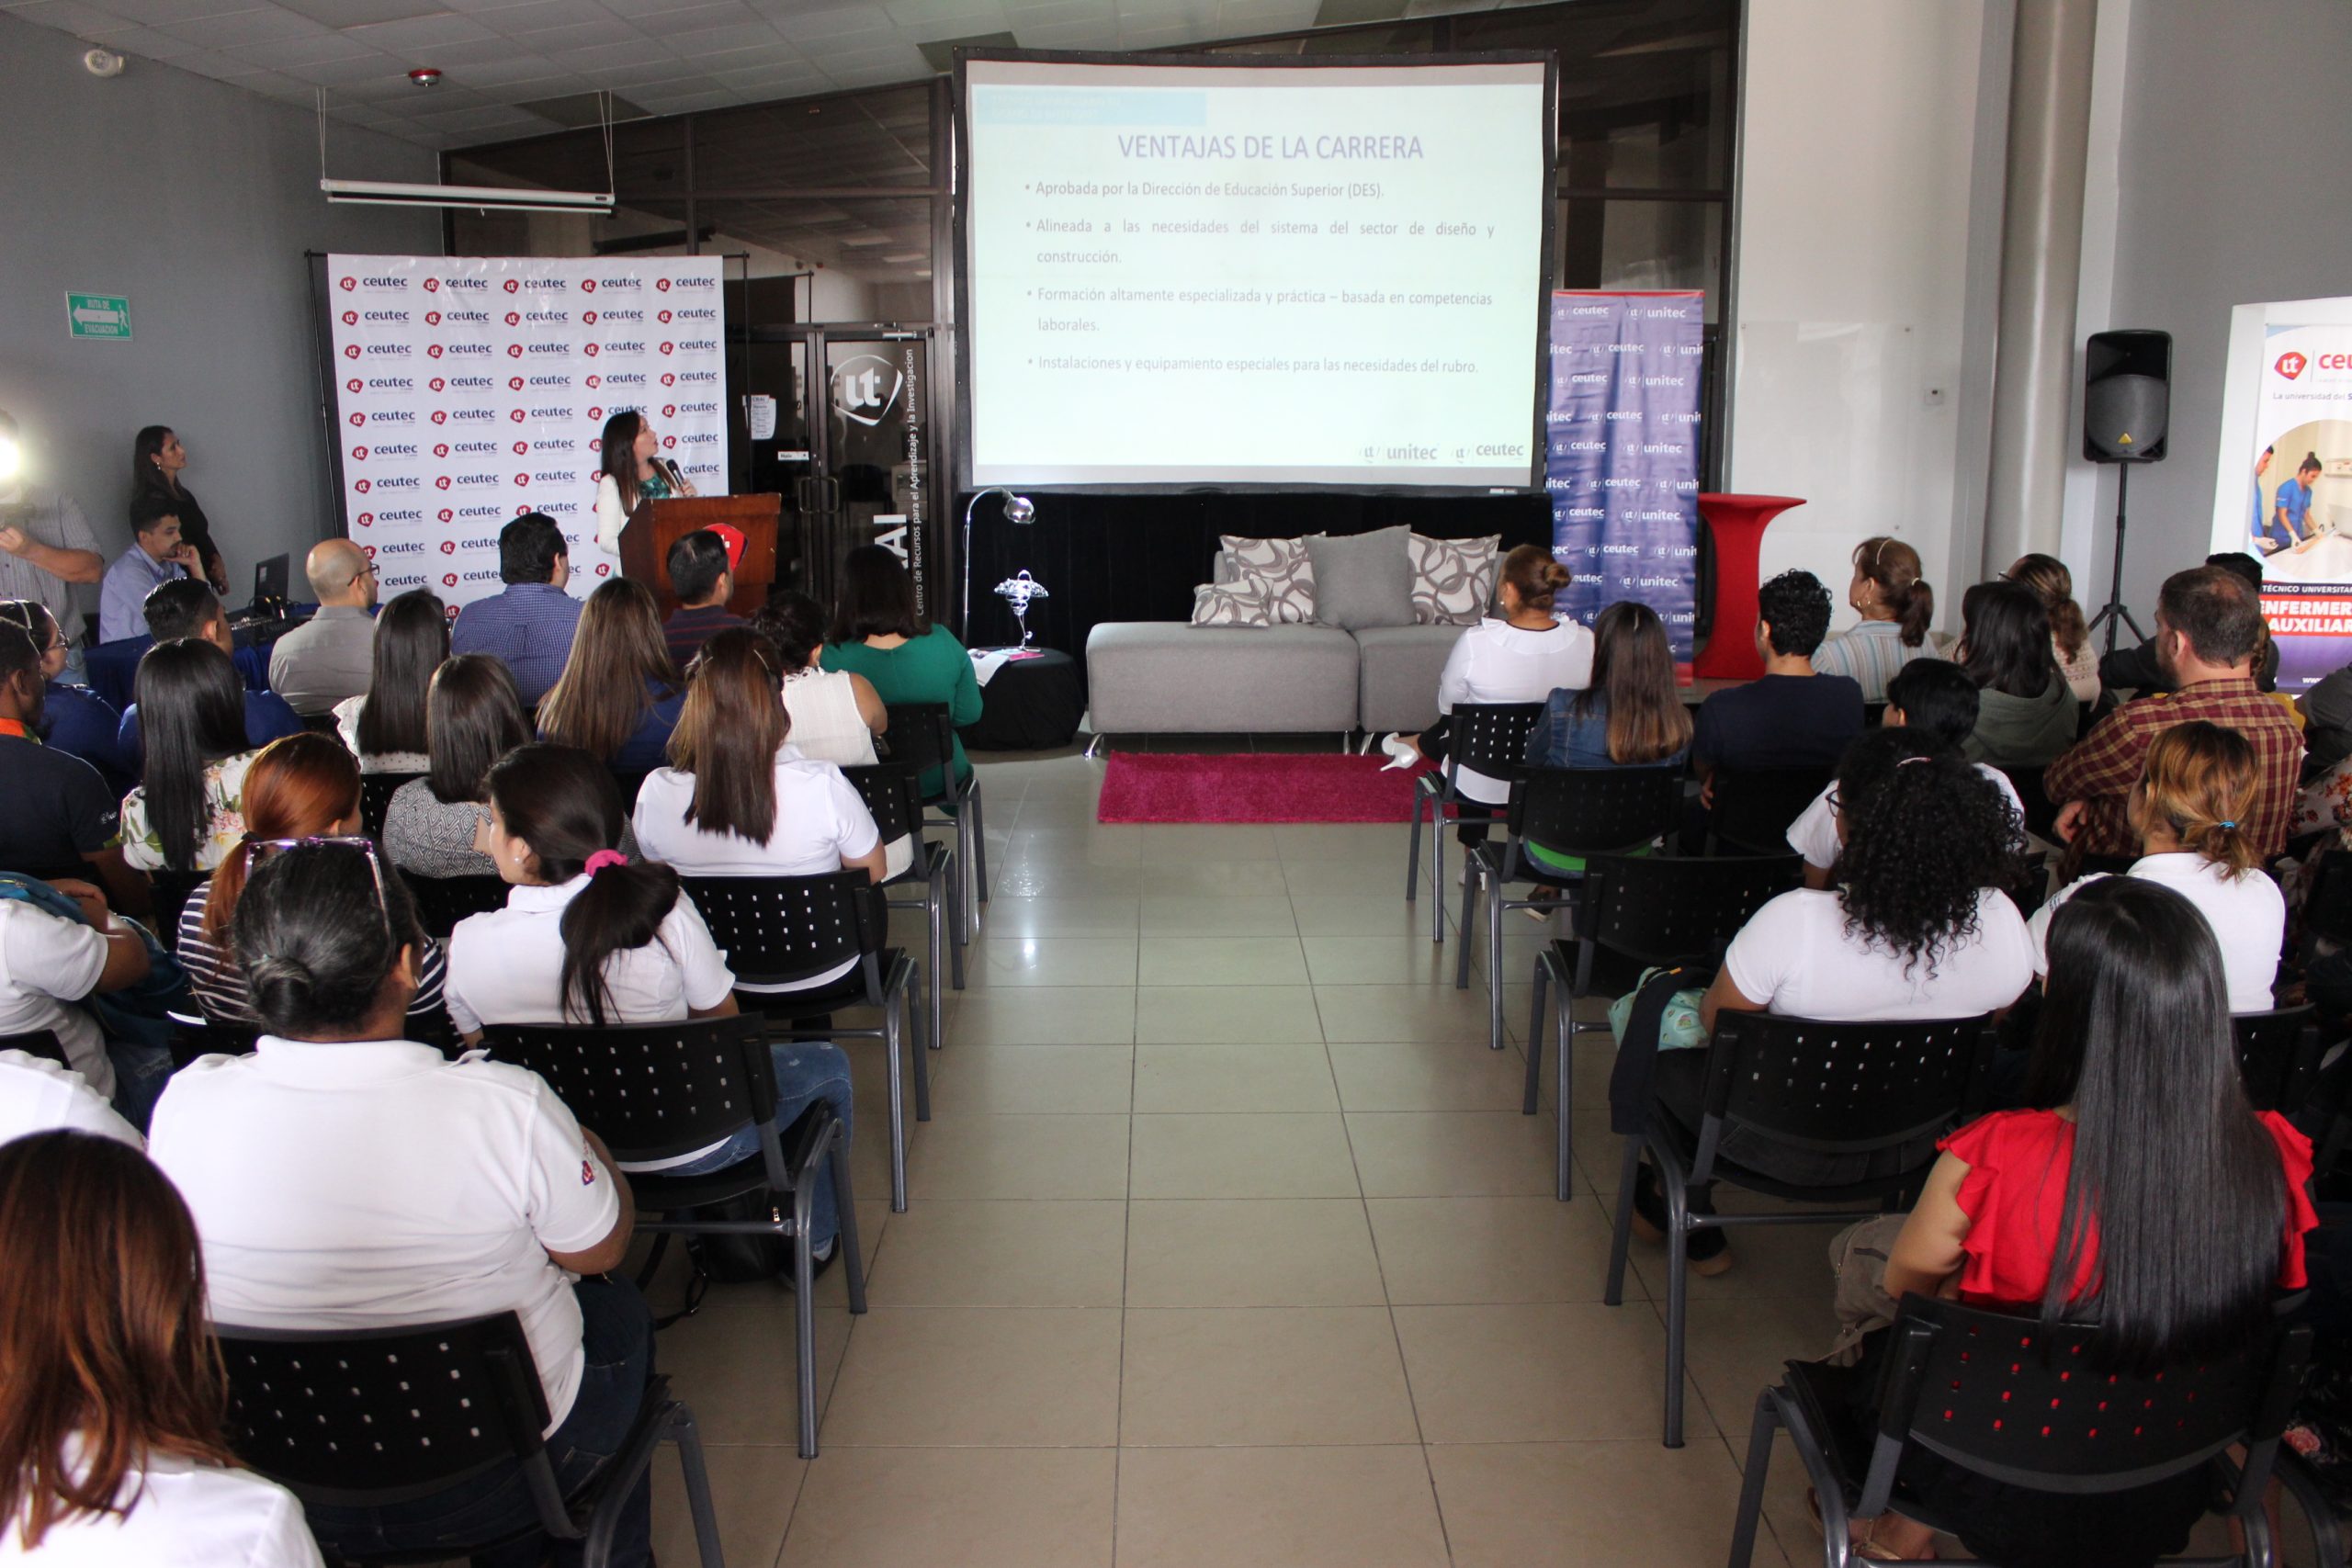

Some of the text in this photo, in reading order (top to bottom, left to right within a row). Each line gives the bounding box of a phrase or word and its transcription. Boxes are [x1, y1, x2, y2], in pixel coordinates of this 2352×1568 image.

[1118, 135, 1424, 159] VENTAJAS DE LA CARRERA
[1035, 181, 1384, 199] Aprobada por la Dirección de Educación Superior (DES).
[1036, 220, 1495, 239] Alineada a las necesidades del sistema del sector de diseño y
[1036, 250, 1123, 264] construcción.
[362, 276, 408, 288] ceutec
[445, 277, 488, 288] ceutec
[524, 278, 567, 289] ceutec
[601, 277, 641, 288] ceutec
[675, 276, 715, 288] ceutec
[1037, 287, 1493, 308] Formación altamente especializada y práctica basada en competencias
[364, 310, 410, 321] ceutec
[447, 310, 490, 321] ceutec
[526, 310, 569, 321] ceutec
[602, 310, 644, 320] ceutec
[677, 309, 716, 319] ceutec
[1573, 306, 1610, 316] ceutec
[1646, 307, 1687, 318] unitec
[1038, 317, 1101, 332] laborales.
[367, 344, 412, 355] ceutec
[448, 344, 492, 354] ceutec
[528, 343, 570, 354] ceutec
[605, 341, 645, 352] ceutec
[679, 340, 717, 350] ceutec
[1608, 343, 1645, 353] ceutec
[1039, 355, 1479, 374] Instalaciones y equipamiento especiales para las necesidades del rubro.
[529, 375, 571, 386] ceutec
[605, 373, 647, 384] ceutec
[680, 371, 718, 381] ceutec
[1571, 374, 1608, 383] ceutec
[1645, 375, 1684, 386] unitec
[368, 377, 413, 388] ceutec
[450, 377, 493, 387] ceutec
[2285, 392, 2333, 400] universidad
[2334, 392, 2346, 400] del
[680, 401, 718, 412] ceutec
[371, 411, 415, 422] ceutec
[452, 409, 495, 420] ceutec
[531, 407, 573, 418] ceutec
[1606, 411, 1643, 421] ceutec
[906, 414, 916, 423] la
[909, 424, 919, 433] y
[681, 433, 718, 444] ceutec
[374, 444, 418, 455] ceutec
[454, 441, 497, 452] ceutec
[533, 439, 575, 450] ceutec
[1476, 443, 1524, 457] ceutec
[1570, 441, 1607, 450] ceutec
[1644, 443, 1683, 454] unitec
[1386, 444, 1438, 460] unitec
[908, 433, 921, 490] Aprendizaje
[683, 464, 719, 474] ceutec
[456, 473, 499, 484] ceutec
[535, 470, 576, 481] ceutec
[376, 477, 421, 488] ceutec
[1604, 478, 1641, 487] ceutec
[910, 491, 919, 501] el
[458, 506, 501, 517] ceutec
[536, 502, 579, 513] ceutec
[1568, 508, 1605, 516] ceutec
[379, 509, 423, 521] ceutec
[912, 503, 922, 524] para
[1642, 510, 1680, 521] unitec
[381, 542, 425, 554] ceutec
[913, 525, 922, 568] Recursos
[1602, 545, 1639, 553] ceutec
[384, 575, 427, 587] ceutec
[913, 570, 922, 582] de
[1572, 573, 1603, 582] eutec
[1640, 576, 1679, 587] unitec
[2263, 584, 2300, 593] TÉCNICO
[916, 584, 924, 616] Centro
